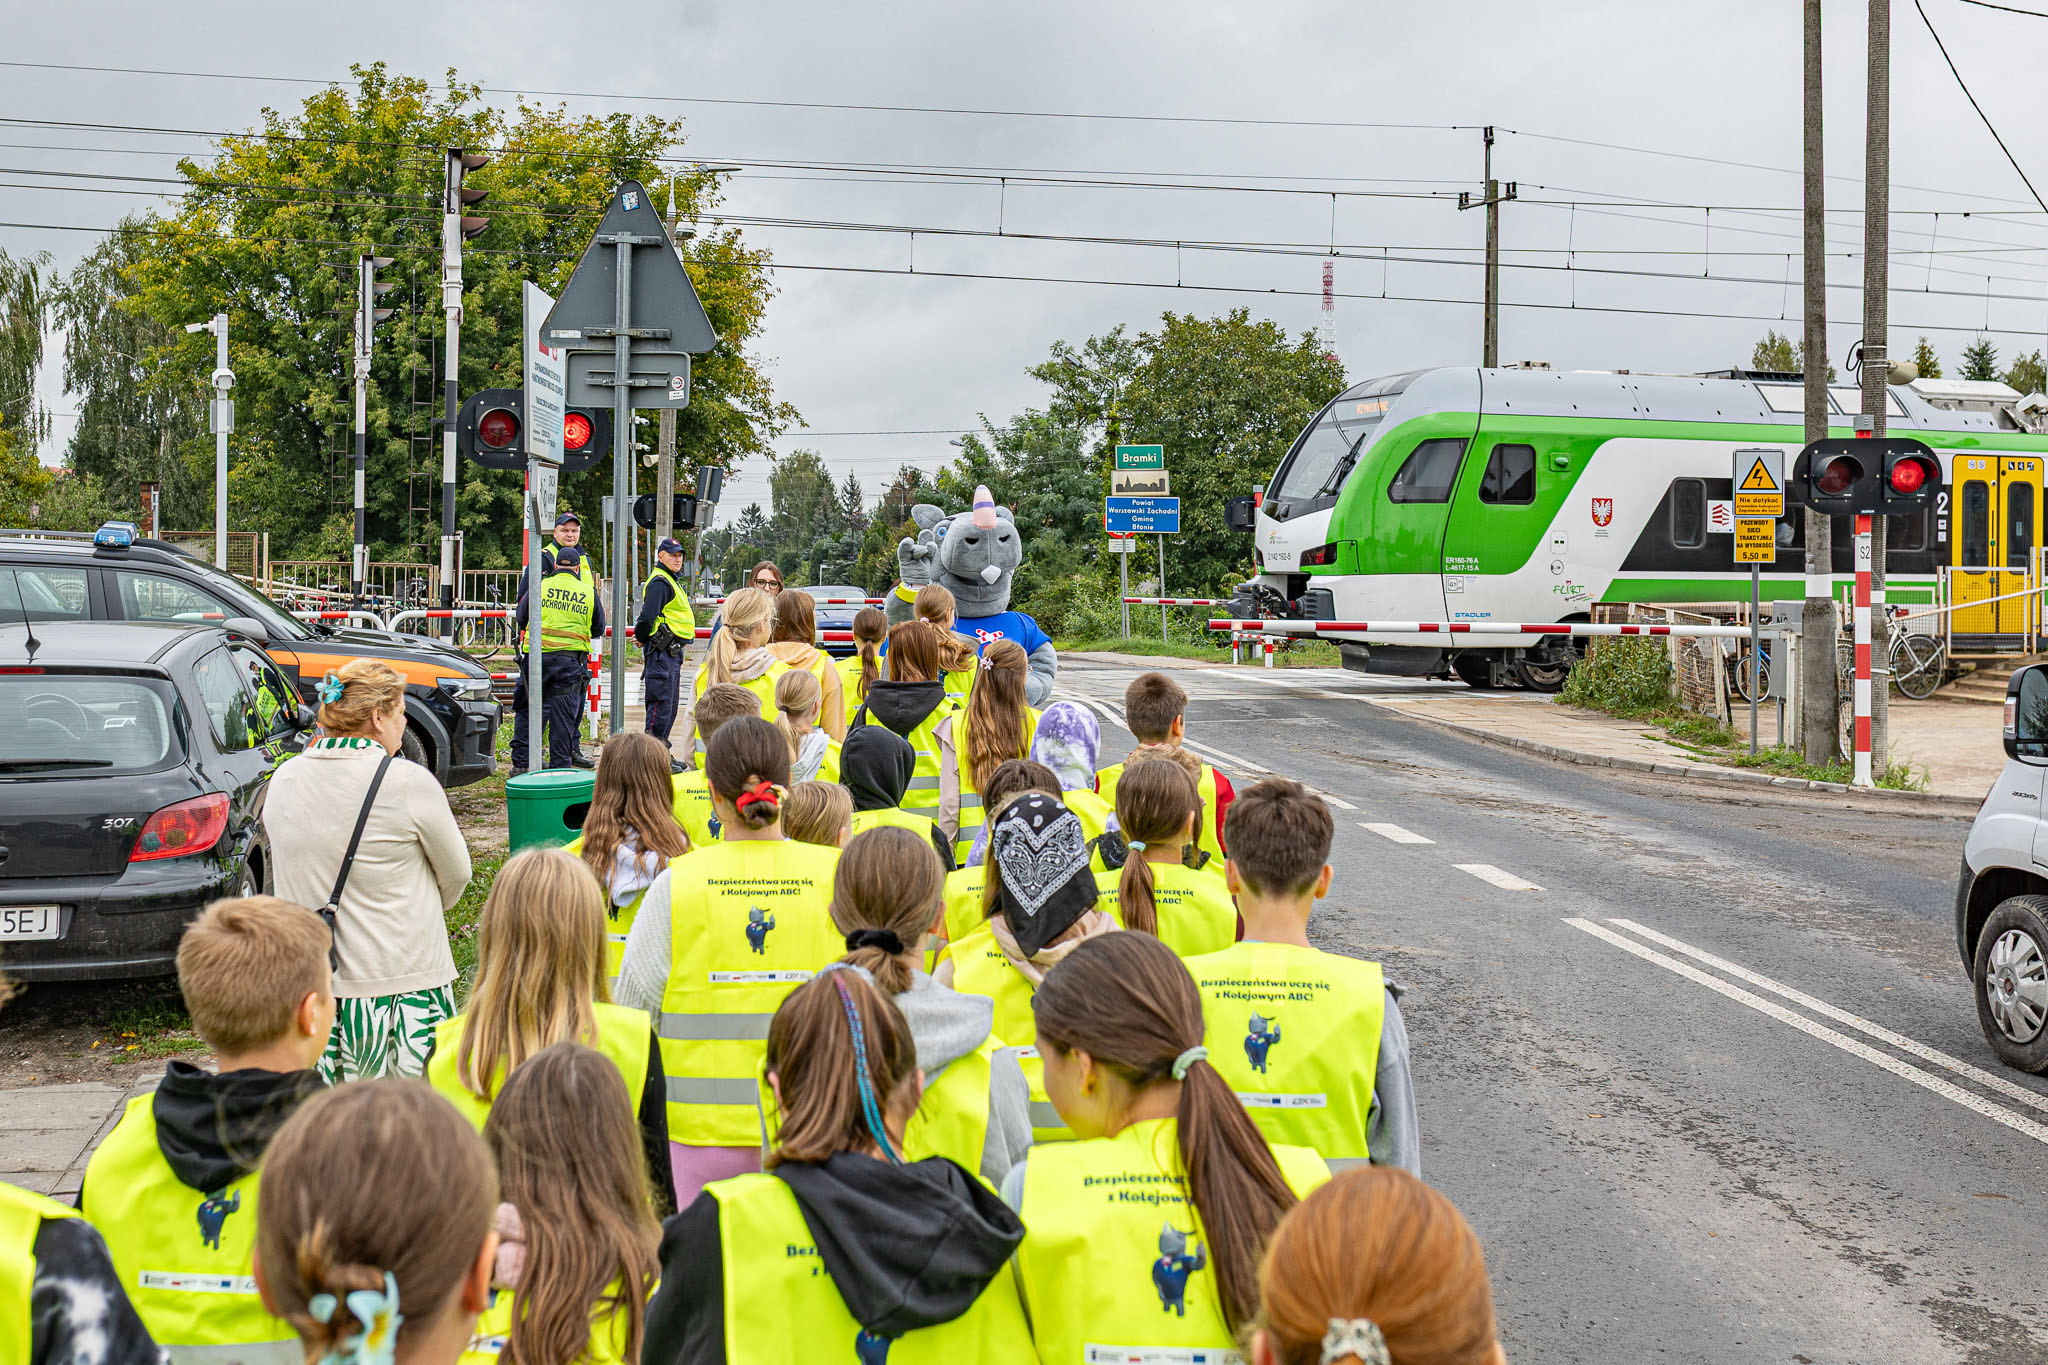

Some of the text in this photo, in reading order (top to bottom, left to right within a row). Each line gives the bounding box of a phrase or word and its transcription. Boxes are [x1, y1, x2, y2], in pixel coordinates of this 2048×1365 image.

[1122, 453, 1157, 463] Bramki
[1936, 492, 1949, 515] 2
[1743, 552, 1759, 560] 5,50
[1860, 545, 1870, 560] S2
[1553, 585, 1585, 594] FLIRT
[546, 588, 586, 604] STRAŻ
[541, 599, 588, 615] OCHRONY KOLEI
[102, 818, 134, 829] 307
[708, 877, 813, 887] Bezpieczeństwa uczę się
[727, 888, 778, 897] Kolejowym
[1182, 888, 1194, 896] się
[0, 910, 48, 933] 5EJ
[1201, 977, 1330, 991] Bezpieczeństwa uczę się
[1223, 990, 1286, 1002] Kolejowym
[1288, 992, 1313, 1001] ABC!
